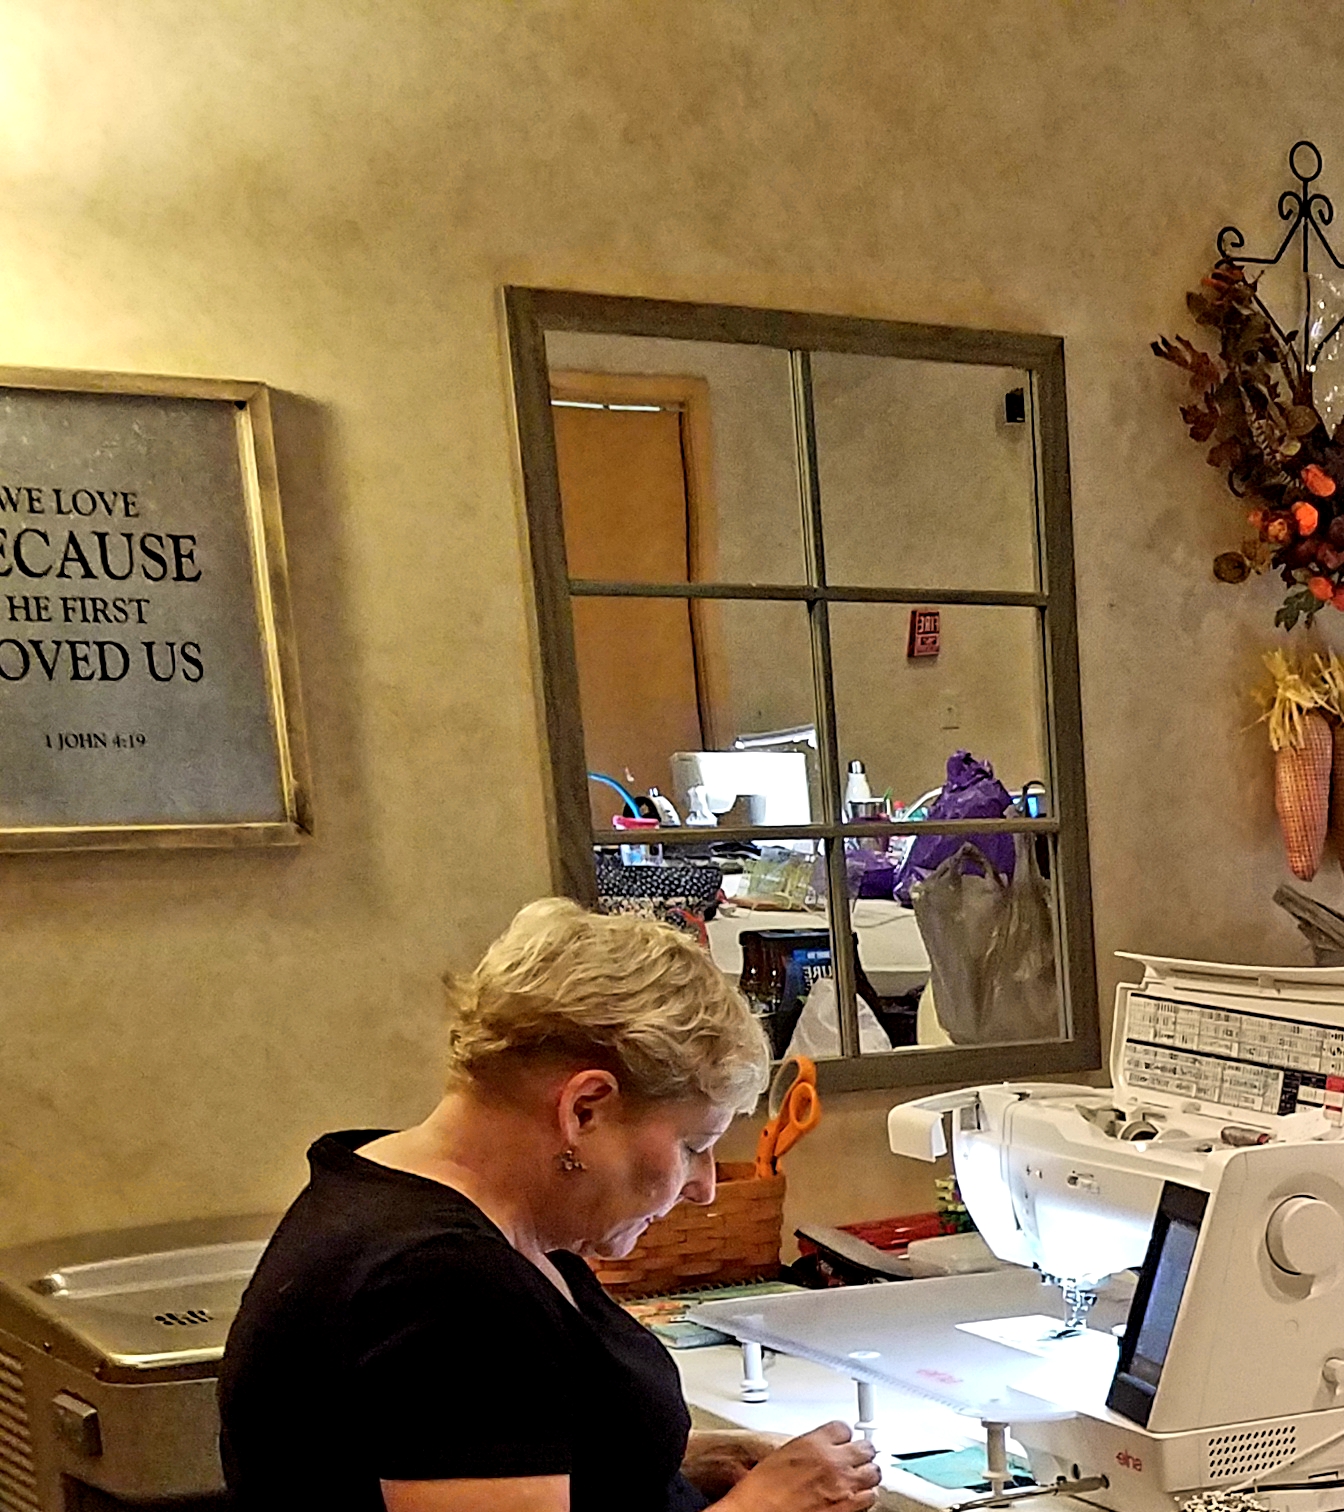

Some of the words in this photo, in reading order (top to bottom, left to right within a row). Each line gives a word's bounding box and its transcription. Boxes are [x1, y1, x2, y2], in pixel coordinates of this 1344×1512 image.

[0, 485, 45, 514] WE
[52, 488, 140, 518] LOVE
[0, 527, 203, 583] CAUSE
[6, 595, 52, 622] HE
[59, 597, 150, 624] FIRST
[0, 638, 130, 681] OVED
[141, 641, 204, 683] US
[57, 732, 108, 751] JOHN
[112, 733, 146, 749] 4:19
